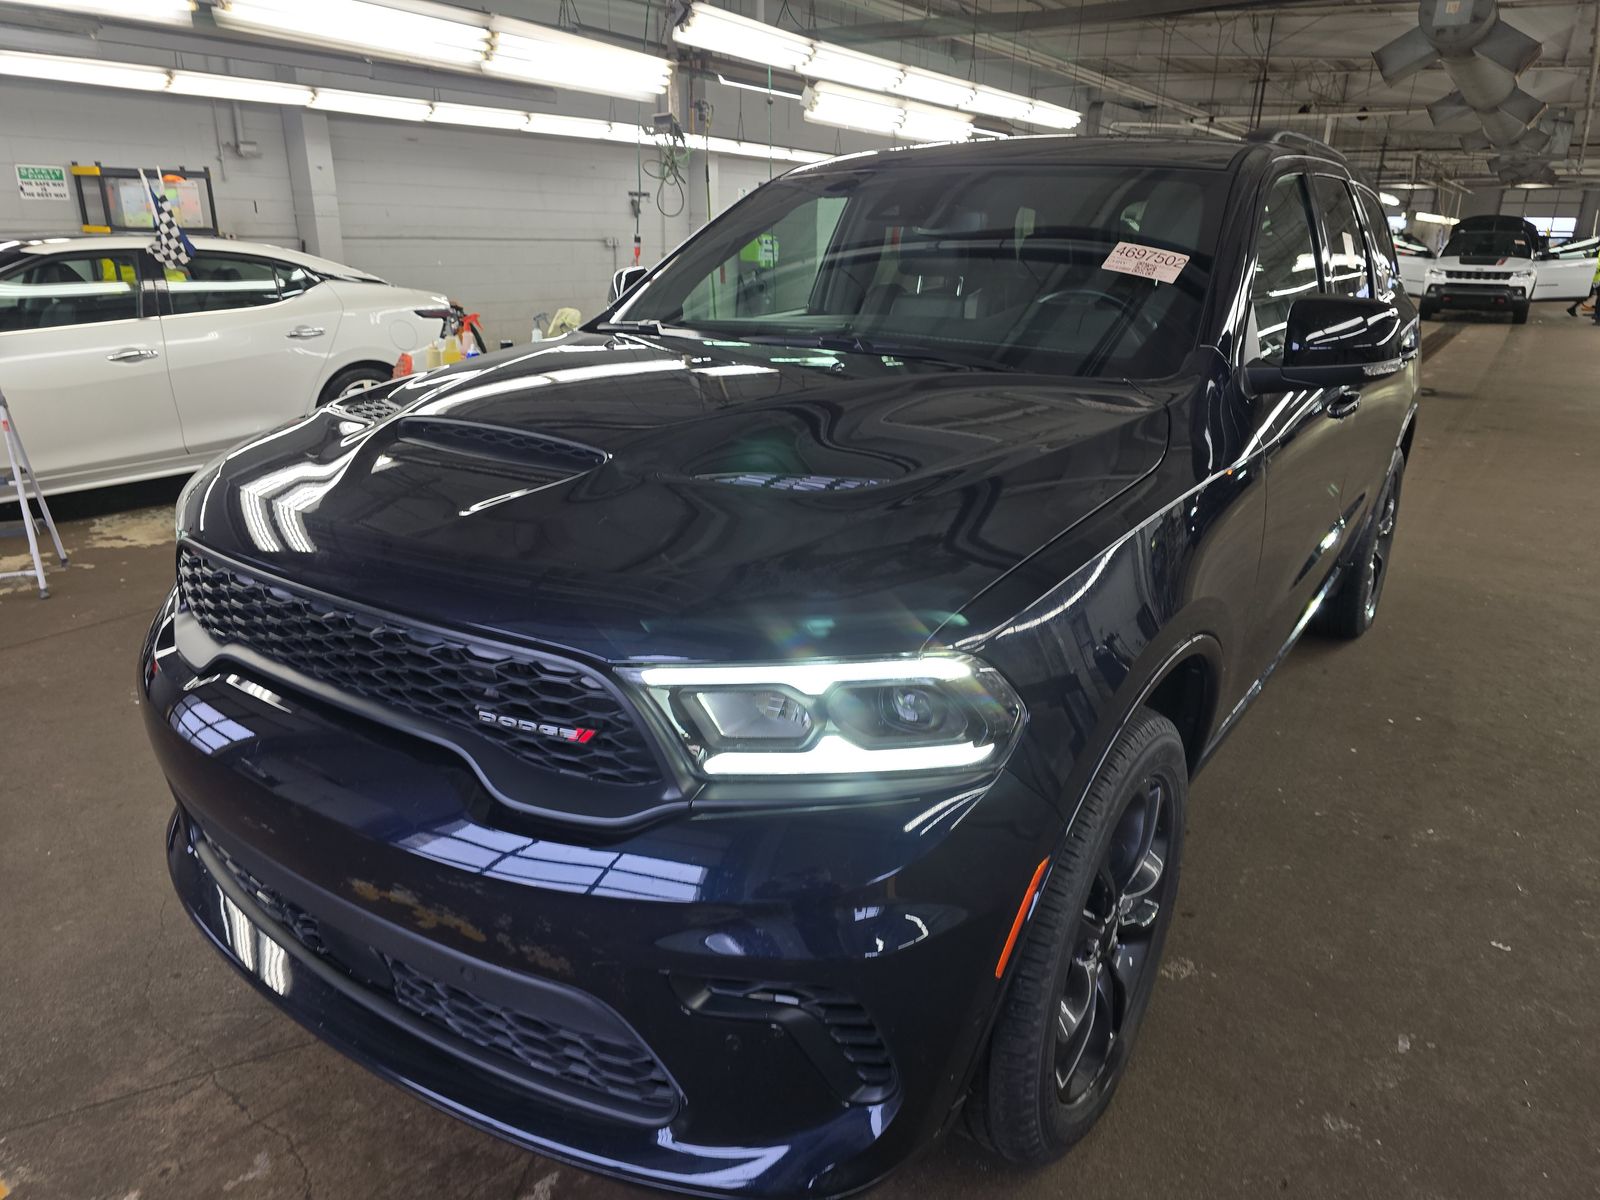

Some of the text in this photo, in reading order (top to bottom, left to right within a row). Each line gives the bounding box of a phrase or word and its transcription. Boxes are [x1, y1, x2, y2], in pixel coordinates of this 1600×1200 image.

[19, 168, 61, 177] SAFETY
[1116, 246, 1187, 268] 4697502
[478, 710, 580, 739] DODGE
